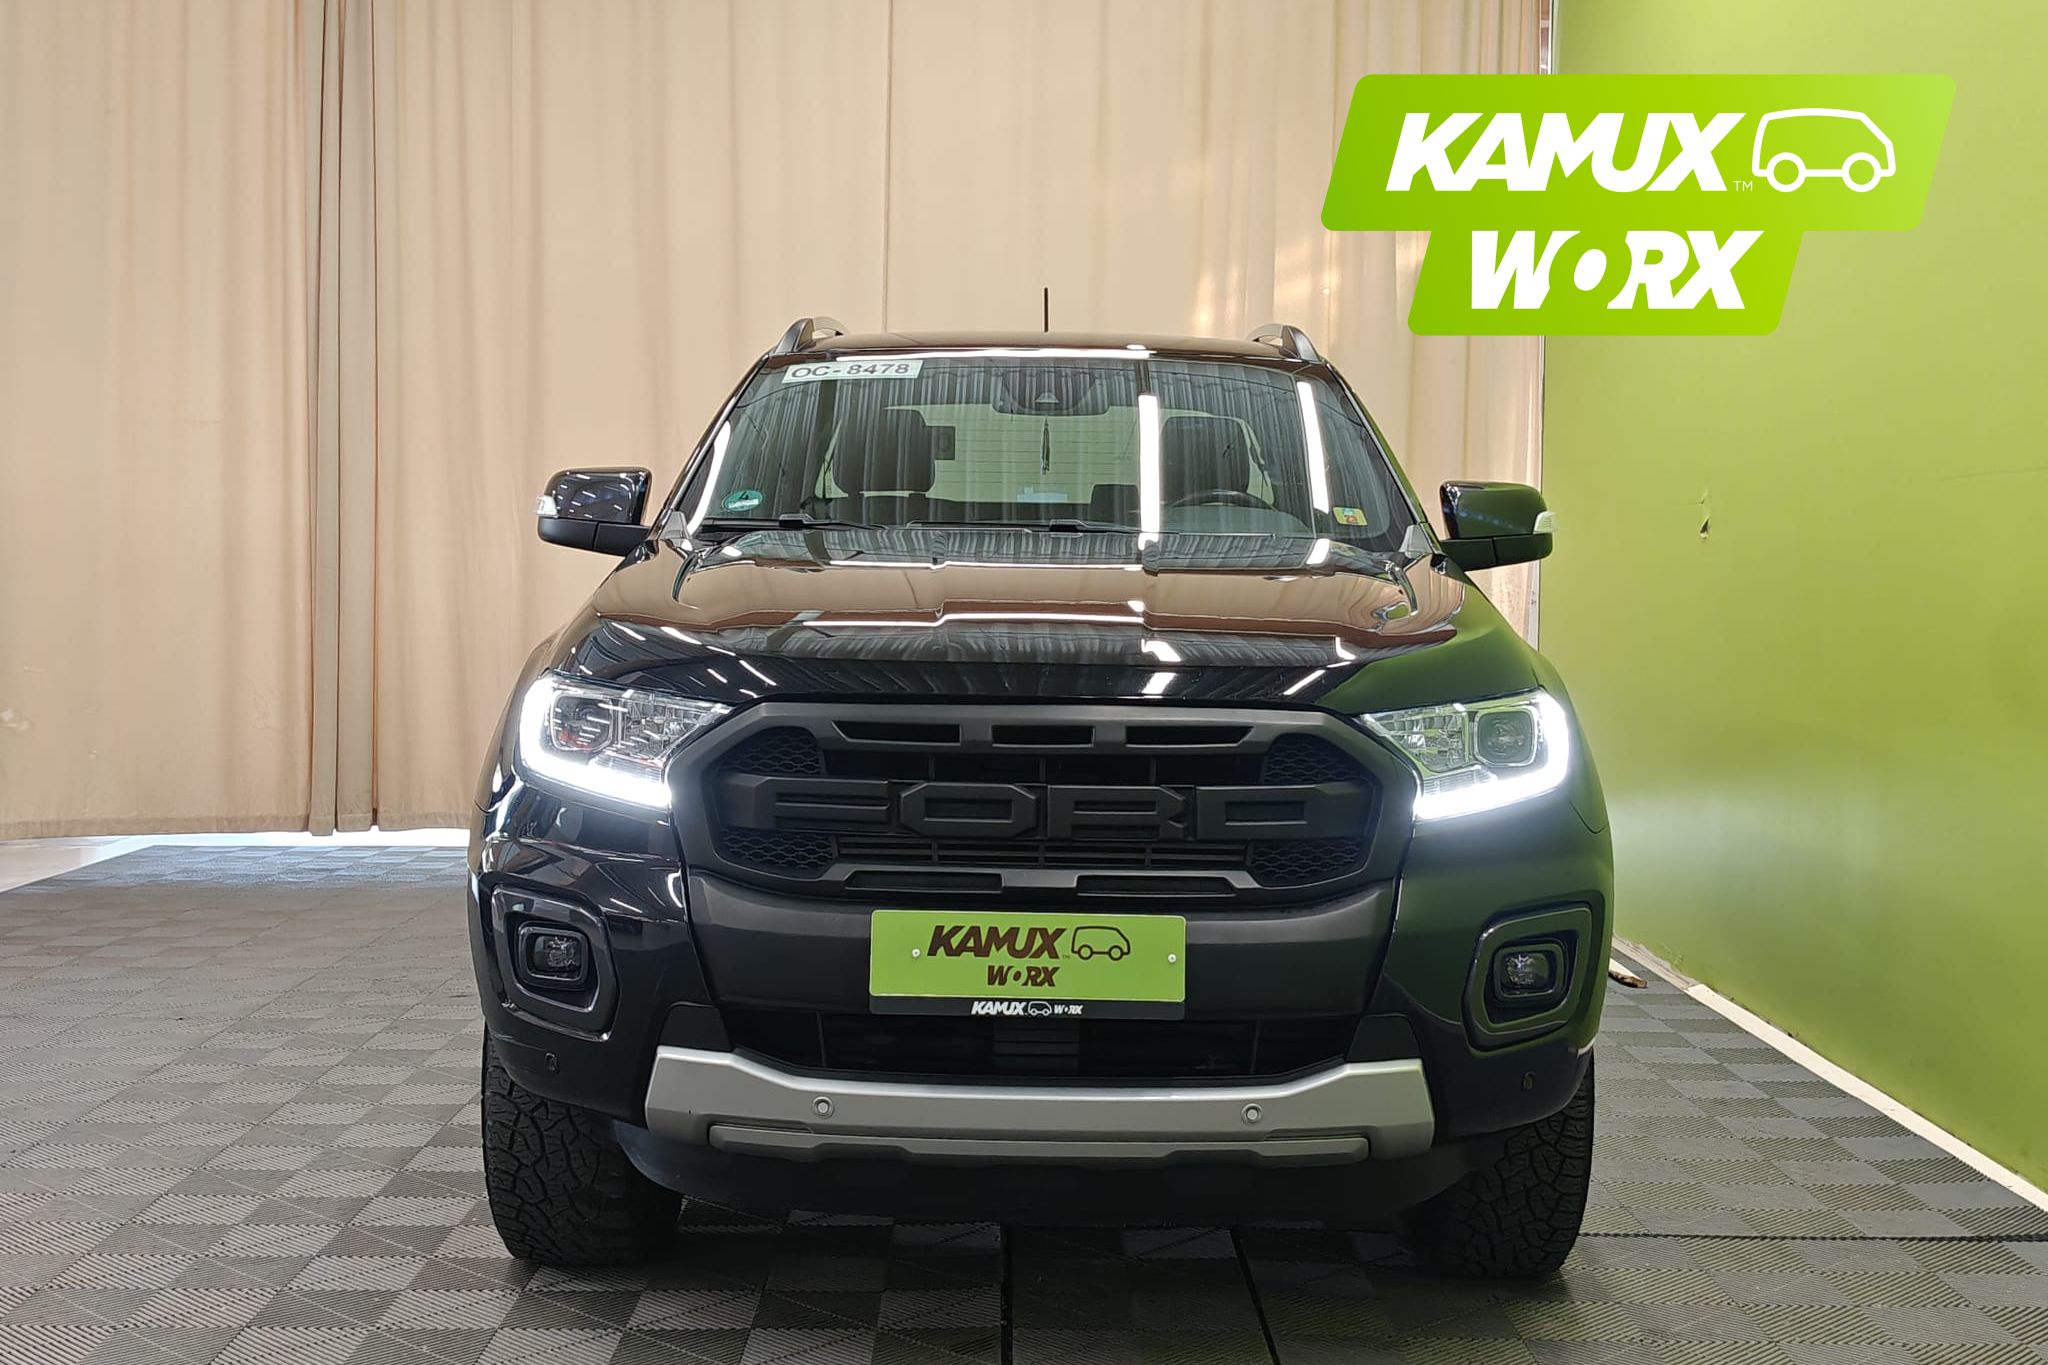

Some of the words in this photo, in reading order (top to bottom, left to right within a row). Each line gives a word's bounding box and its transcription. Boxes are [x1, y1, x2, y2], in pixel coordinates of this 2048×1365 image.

[724, 774, 1368, 840] FORD
[926, 924, 1068, 959] KAMUX
[987, 964, 1061, 987] WORX
[971, 1000, 1028, 1016] KAMUX
[1053, 1004, 1084, 1015] WORX
